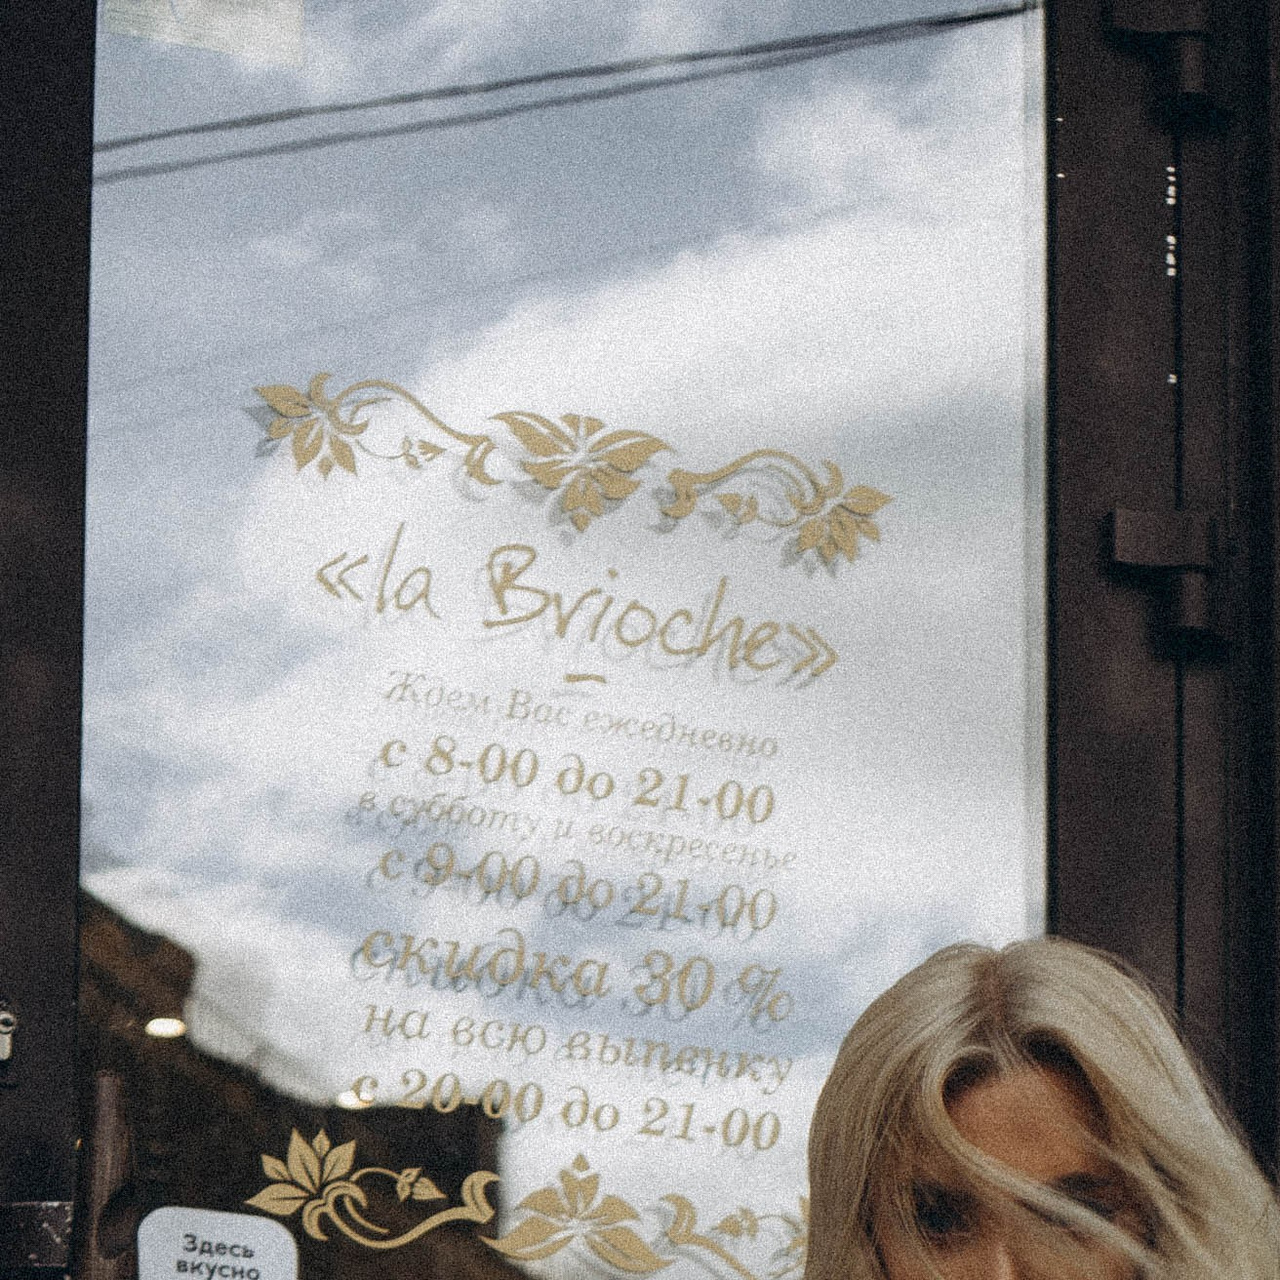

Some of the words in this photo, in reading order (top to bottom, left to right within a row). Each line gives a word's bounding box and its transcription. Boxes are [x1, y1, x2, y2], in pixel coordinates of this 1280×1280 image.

[505, 687, 572, 727] Вас
[583, 709, 780, 759] ежедневно
[379, 737, 407, 768] с
[424, 734, 539, 788] 8-00
[556, 753, 614, 800] до
[633, 766, 775, 824] 21-00
[357, 790, 376, 812] в
[388, 792, 537, 842] субботу
[551, 817, 574, 841] и
[588, 822, 799, 872] воскресенье
[379, 848, 407, 881] с
[424, 842, 540, 898] 9-00
[557, 859, 615, 910] до
[631, 871, 778, 933] 21-00
[361, 926, 611, 998] скидка
[634, 948, 715, 1013] 30
[362, 1002, 430, 1039] на
[450, 1013, 548, 1056] всю
[562, 1029, 795, 1096] выпечку
[350, 1073, 379, 1103] с
[398, 1067, 545, 1124] 20-00
[560, 1085, 620, 1132] до
[638, 1097, 782, 1152] 21-00
[176, 1259, 260, 1280] вкусно
[182, 1232, 255, 1259] Здесь
